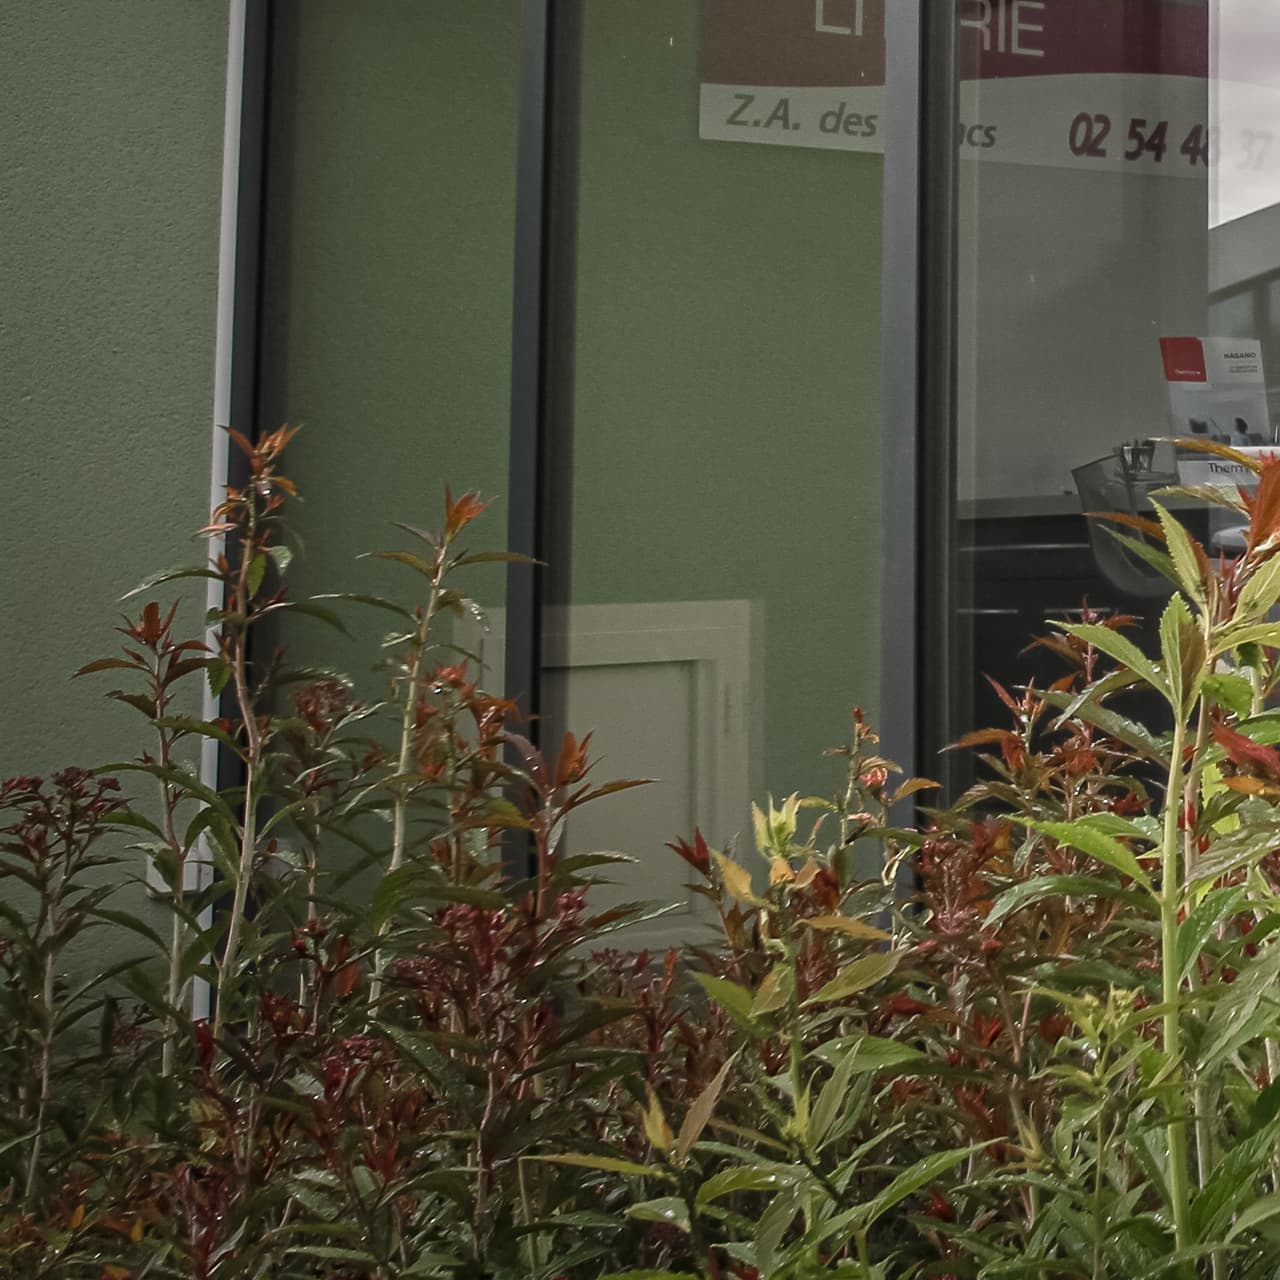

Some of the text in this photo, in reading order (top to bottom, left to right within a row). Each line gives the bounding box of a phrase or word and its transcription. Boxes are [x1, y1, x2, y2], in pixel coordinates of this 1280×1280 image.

[725, 94, 878, 137] Z.A. des
[1069, 112, 1111, 158] 02
[1124, 118, 1168, 162] 54
